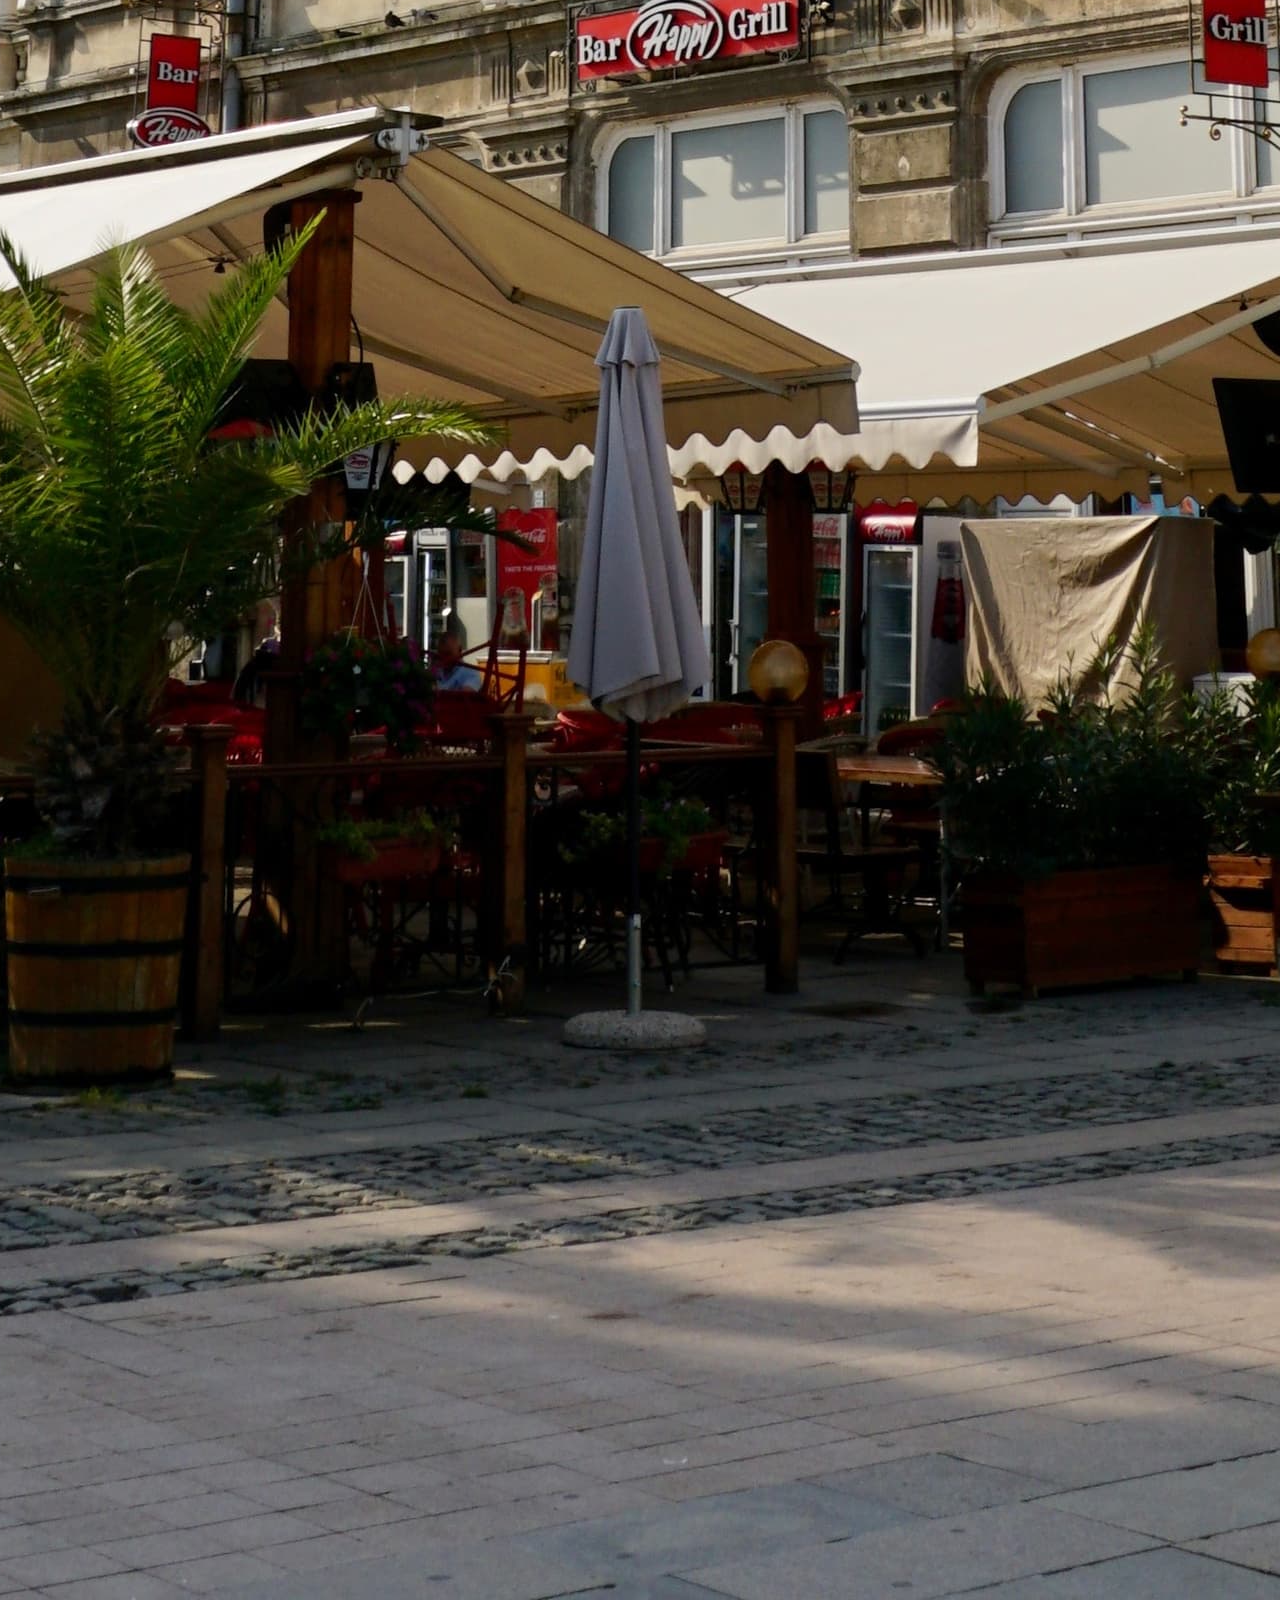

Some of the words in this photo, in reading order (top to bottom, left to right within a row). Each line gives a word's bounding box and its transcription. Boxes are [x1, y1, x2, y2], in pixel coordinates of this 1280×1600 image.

[578, 33, 622, 65] Bar
[637, 13, 715, 62] Happy
[728, 1, 789, 41] Grill
[1210, 13, 1268, 45] Grill
[157, 61, 199, 84] Bar
